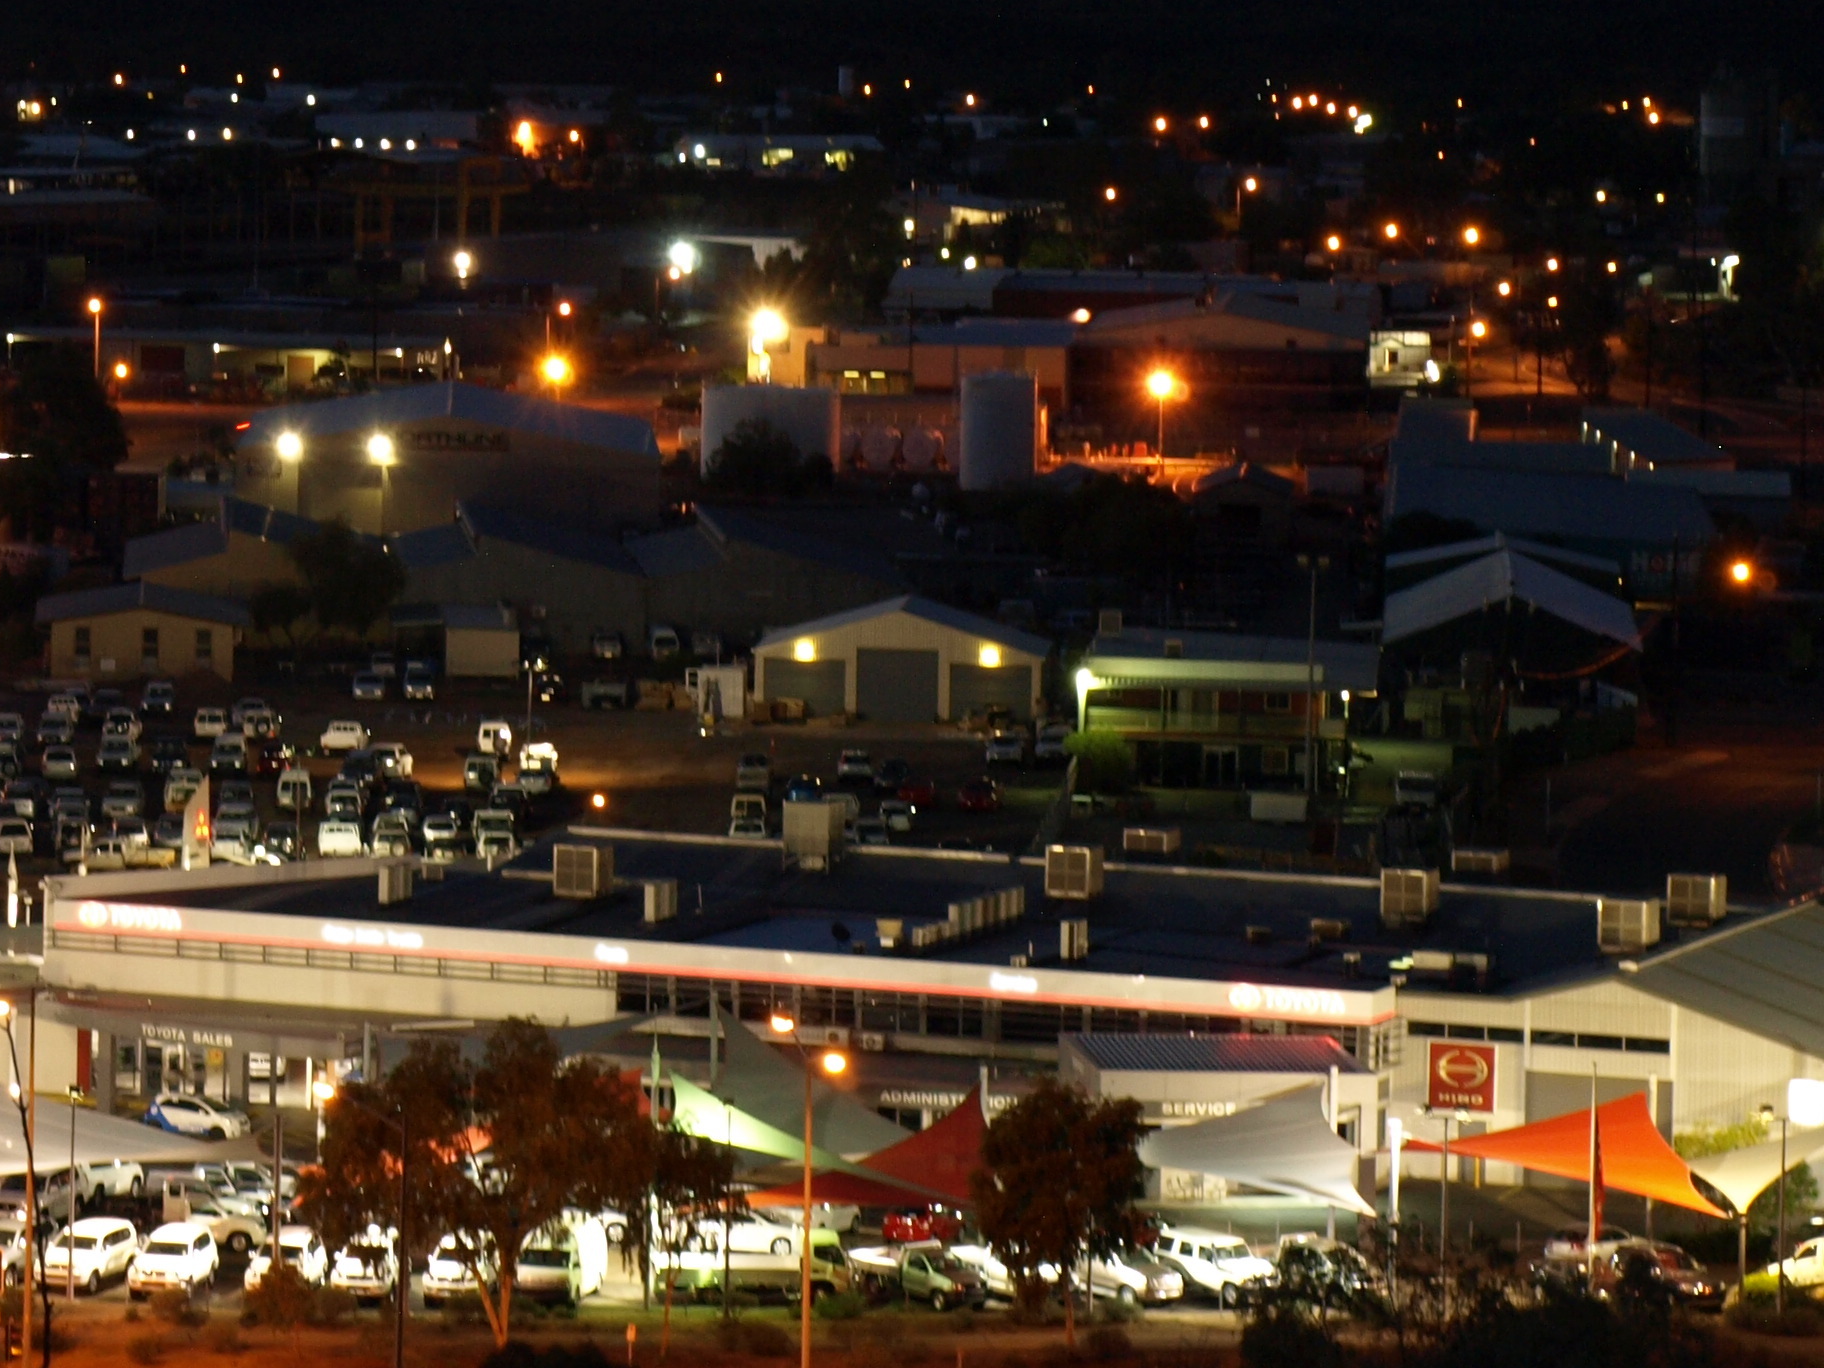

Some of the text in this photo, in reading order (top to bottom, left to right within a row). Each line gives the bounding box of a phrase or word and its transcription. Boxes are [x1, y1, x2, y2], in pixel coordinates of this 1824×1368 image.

[108, 904, 182, 931] TOYOTA
[1261, 985, 1346, 1015] TOYOTA
[141, 1022, 233, 1048] TOYOTA SALES
[1161, 1101, 1237, 1118] SERVICE
[1438, 1091, 1484, 1106] HINO
